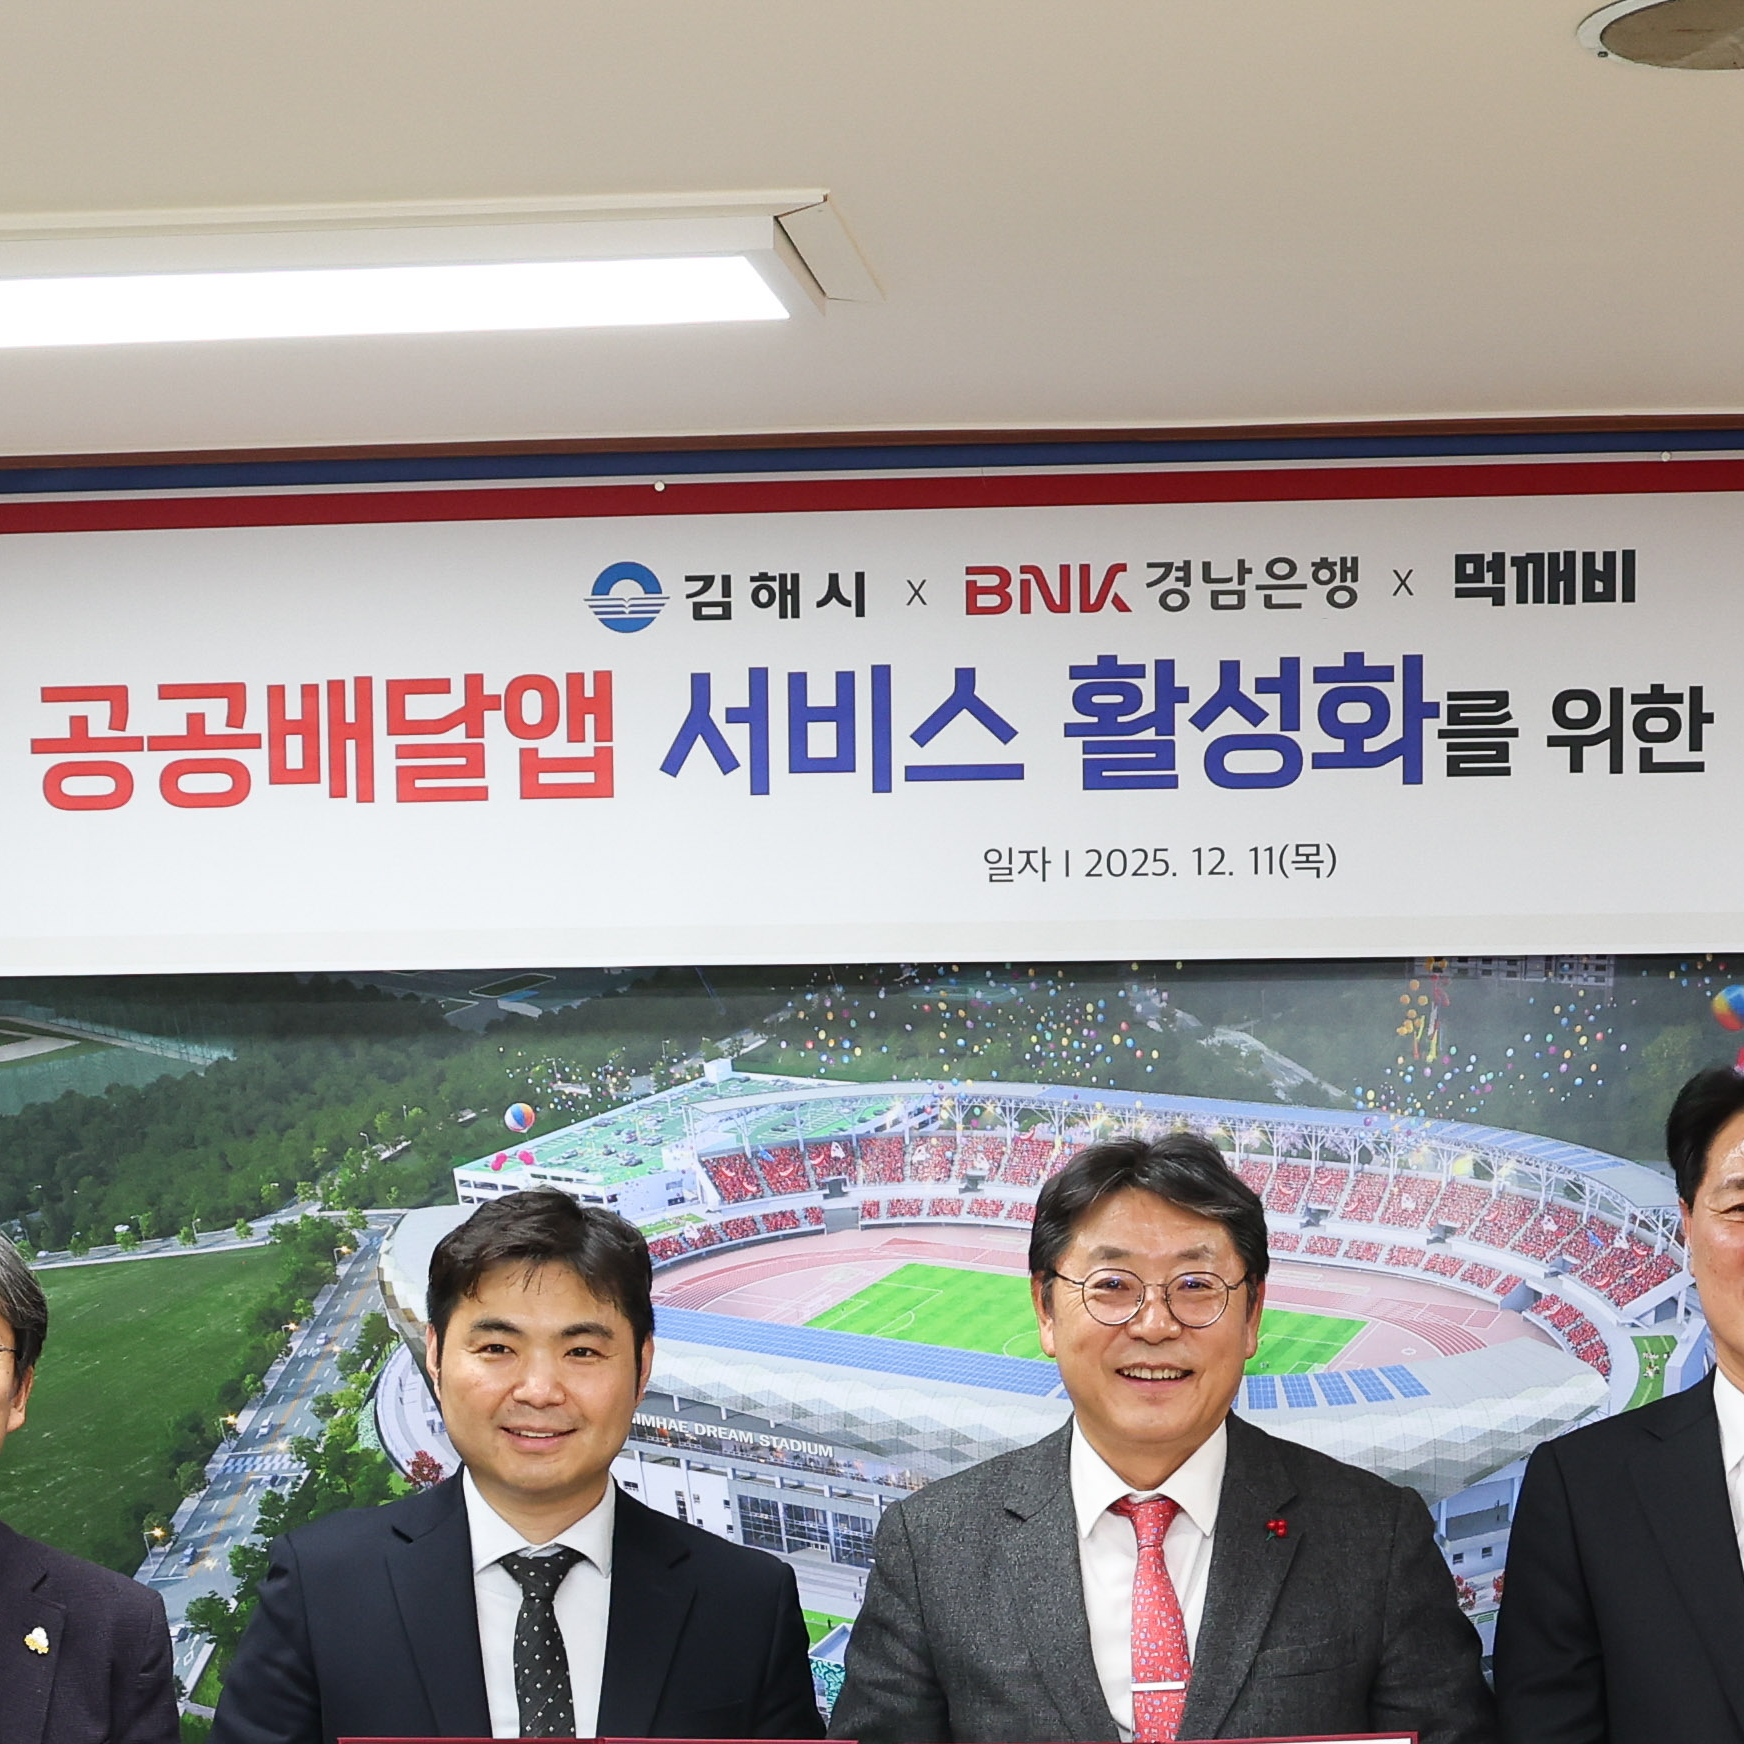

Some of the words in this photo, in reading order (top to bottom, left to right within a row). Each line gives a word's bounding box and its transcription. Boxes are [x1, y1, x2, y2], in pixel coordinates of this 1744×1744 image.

[684, 571, 866, 622] 김해시
[964, 562, 1133, 616] BNK
[1145, 555, 1359, 613] 경남은행
[1454, 548, 1637, 607] 먹깨비
[30, 669, 615, 812] 공공배달앱
[658, 663, 1025, 796] 서비스
[1063, 651, 1520, 791] 활성화를
[1546, 683, 1715, 775] 위한
[983, 845, 1052, 883] 일자
[1084, 847, 1179, 878] 2025.
[1192, 846, 1235, 877] 12.
[1248, 843, 1337, 879] 11(목)
[695, 1422, 754, 1445] DREAM
[759, 1434, 834, 1458] STADIUM
